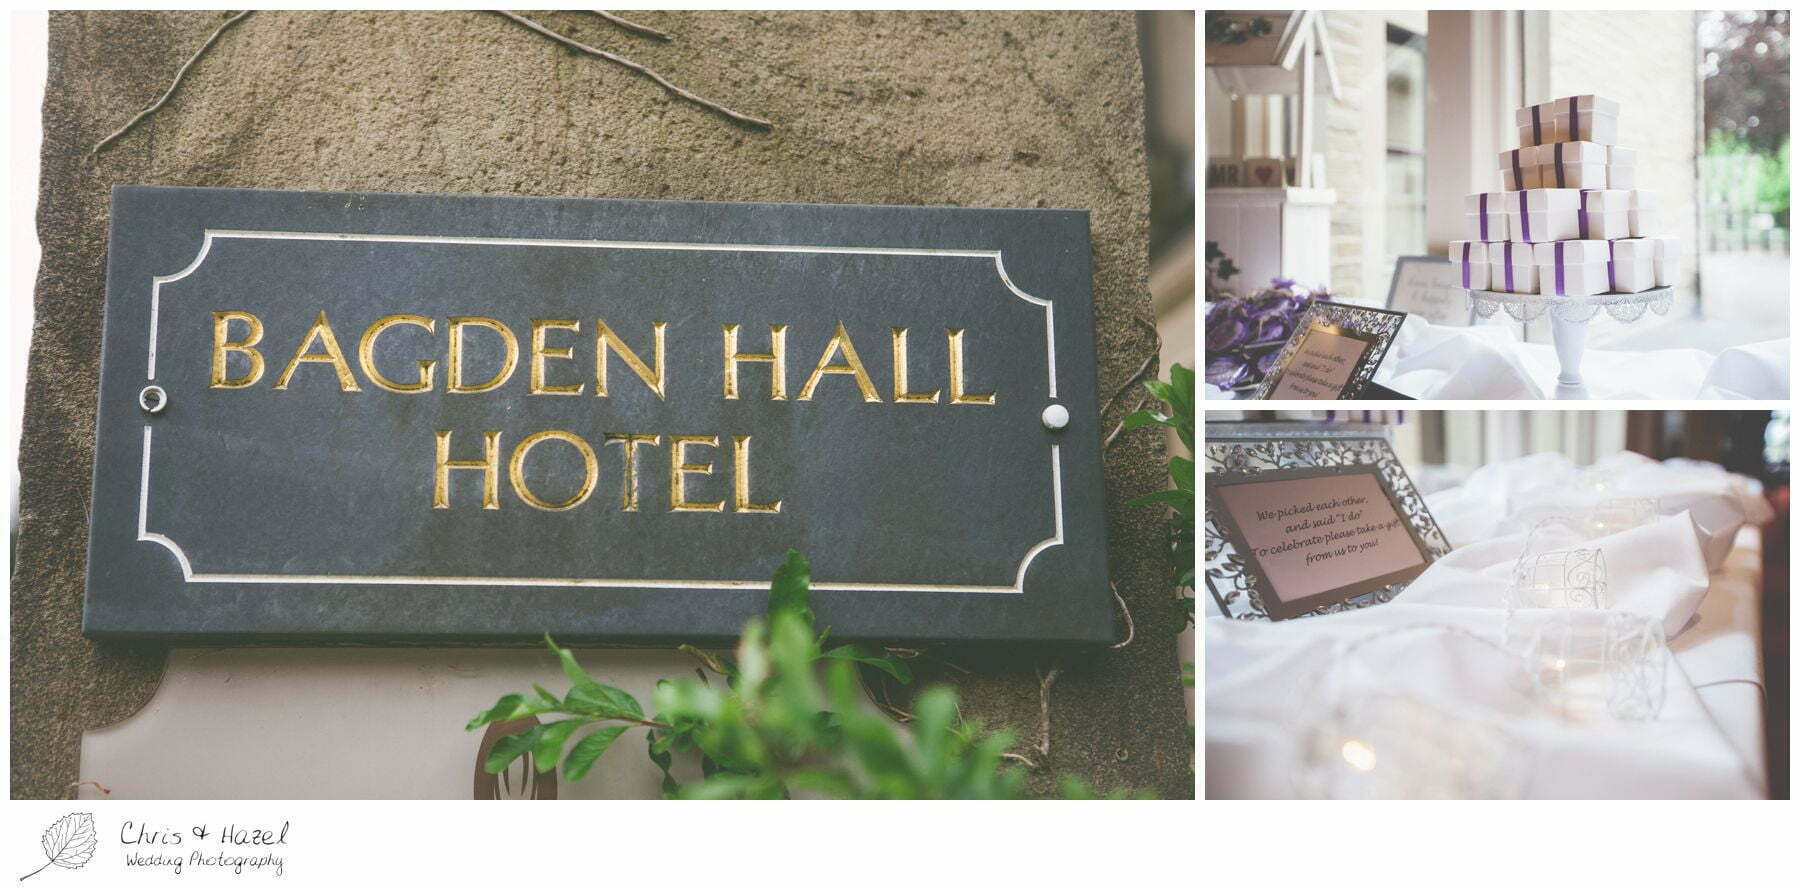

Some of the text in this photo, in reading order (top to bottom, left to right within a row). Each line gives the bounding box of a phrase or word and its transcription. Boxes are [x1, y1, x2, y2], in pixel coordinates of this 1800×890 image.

[209, 308, 998, 406] BAGDEN HALL
[432, 429, 783, 515] HOTEL
[1256, 510, 1274, 521] We
[1276, 502, 1313, 521] picked
[1313, 498, 1340, 512] each
[1285, 518, 1311, 534] and
[1312, 515, 1336, 529] said
[1270, 535, 1324, 555] celebrate
[1324, 528, 1355, 545] please
[1356, 523, 1377, 536] take
[1377, 522, 1385, 530] a
[1304, 538, 1379, 567] from us to you!
